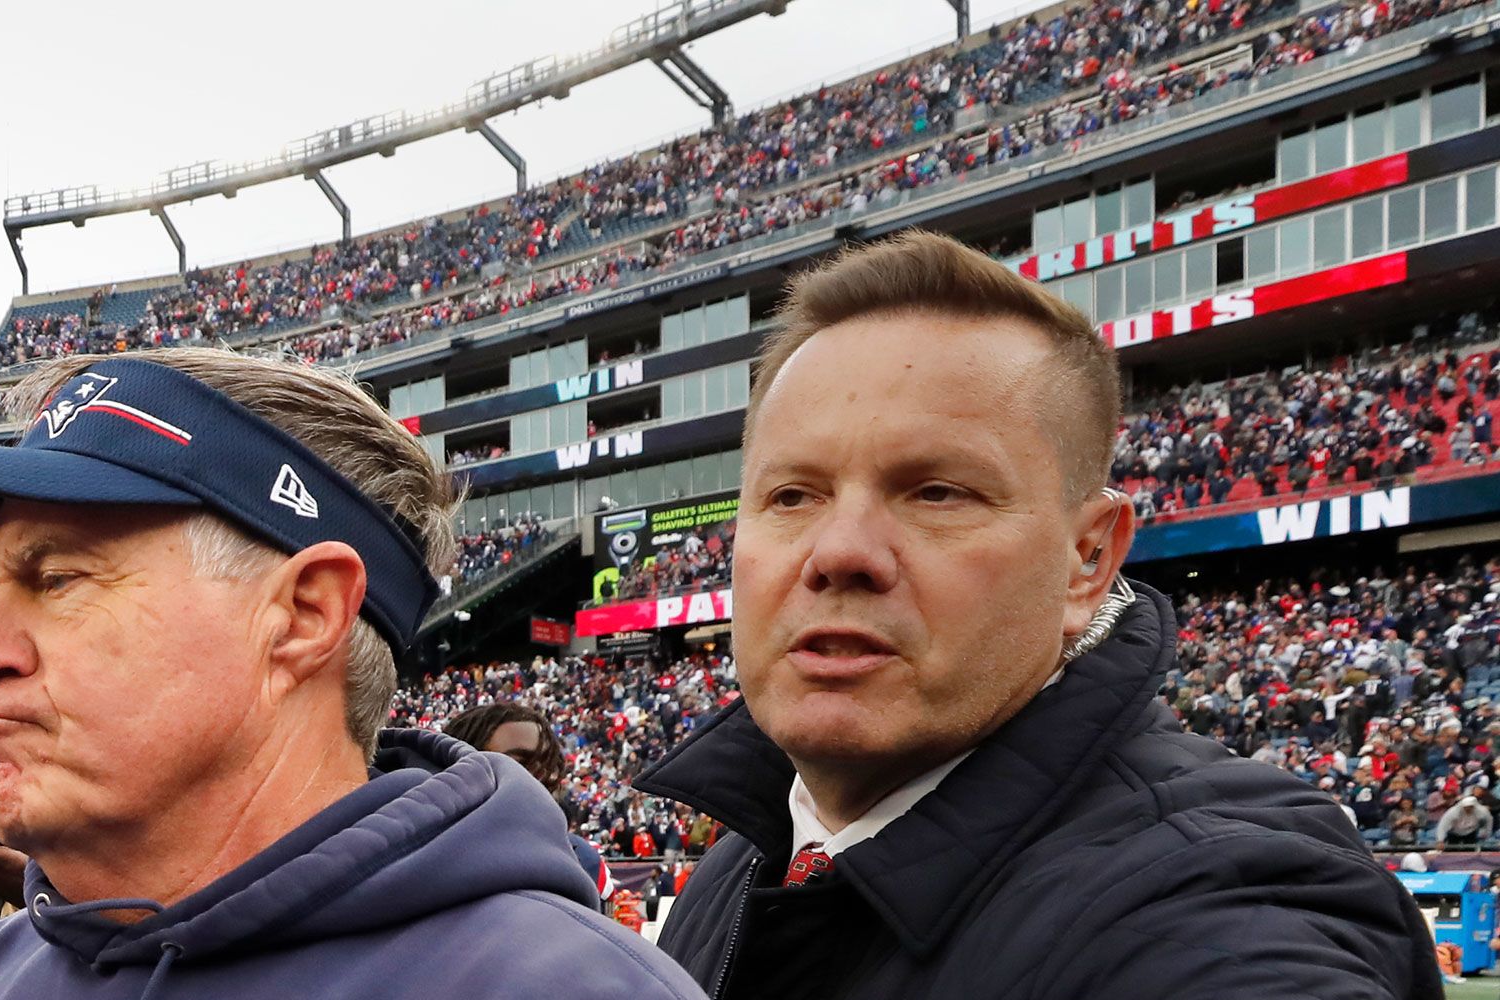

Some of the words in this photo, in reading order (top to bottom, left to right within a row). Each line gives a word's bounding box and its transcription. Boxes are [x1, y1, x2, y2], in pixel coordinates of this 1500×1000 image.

[1098, 287, 1255, 349] OTS
[556, 359, 644, 402] WIN
[556, 430, 644, 471] WIN
[652, 516, 695, 533] SHAVING
[1257, 486, 1411, 545] WIN
